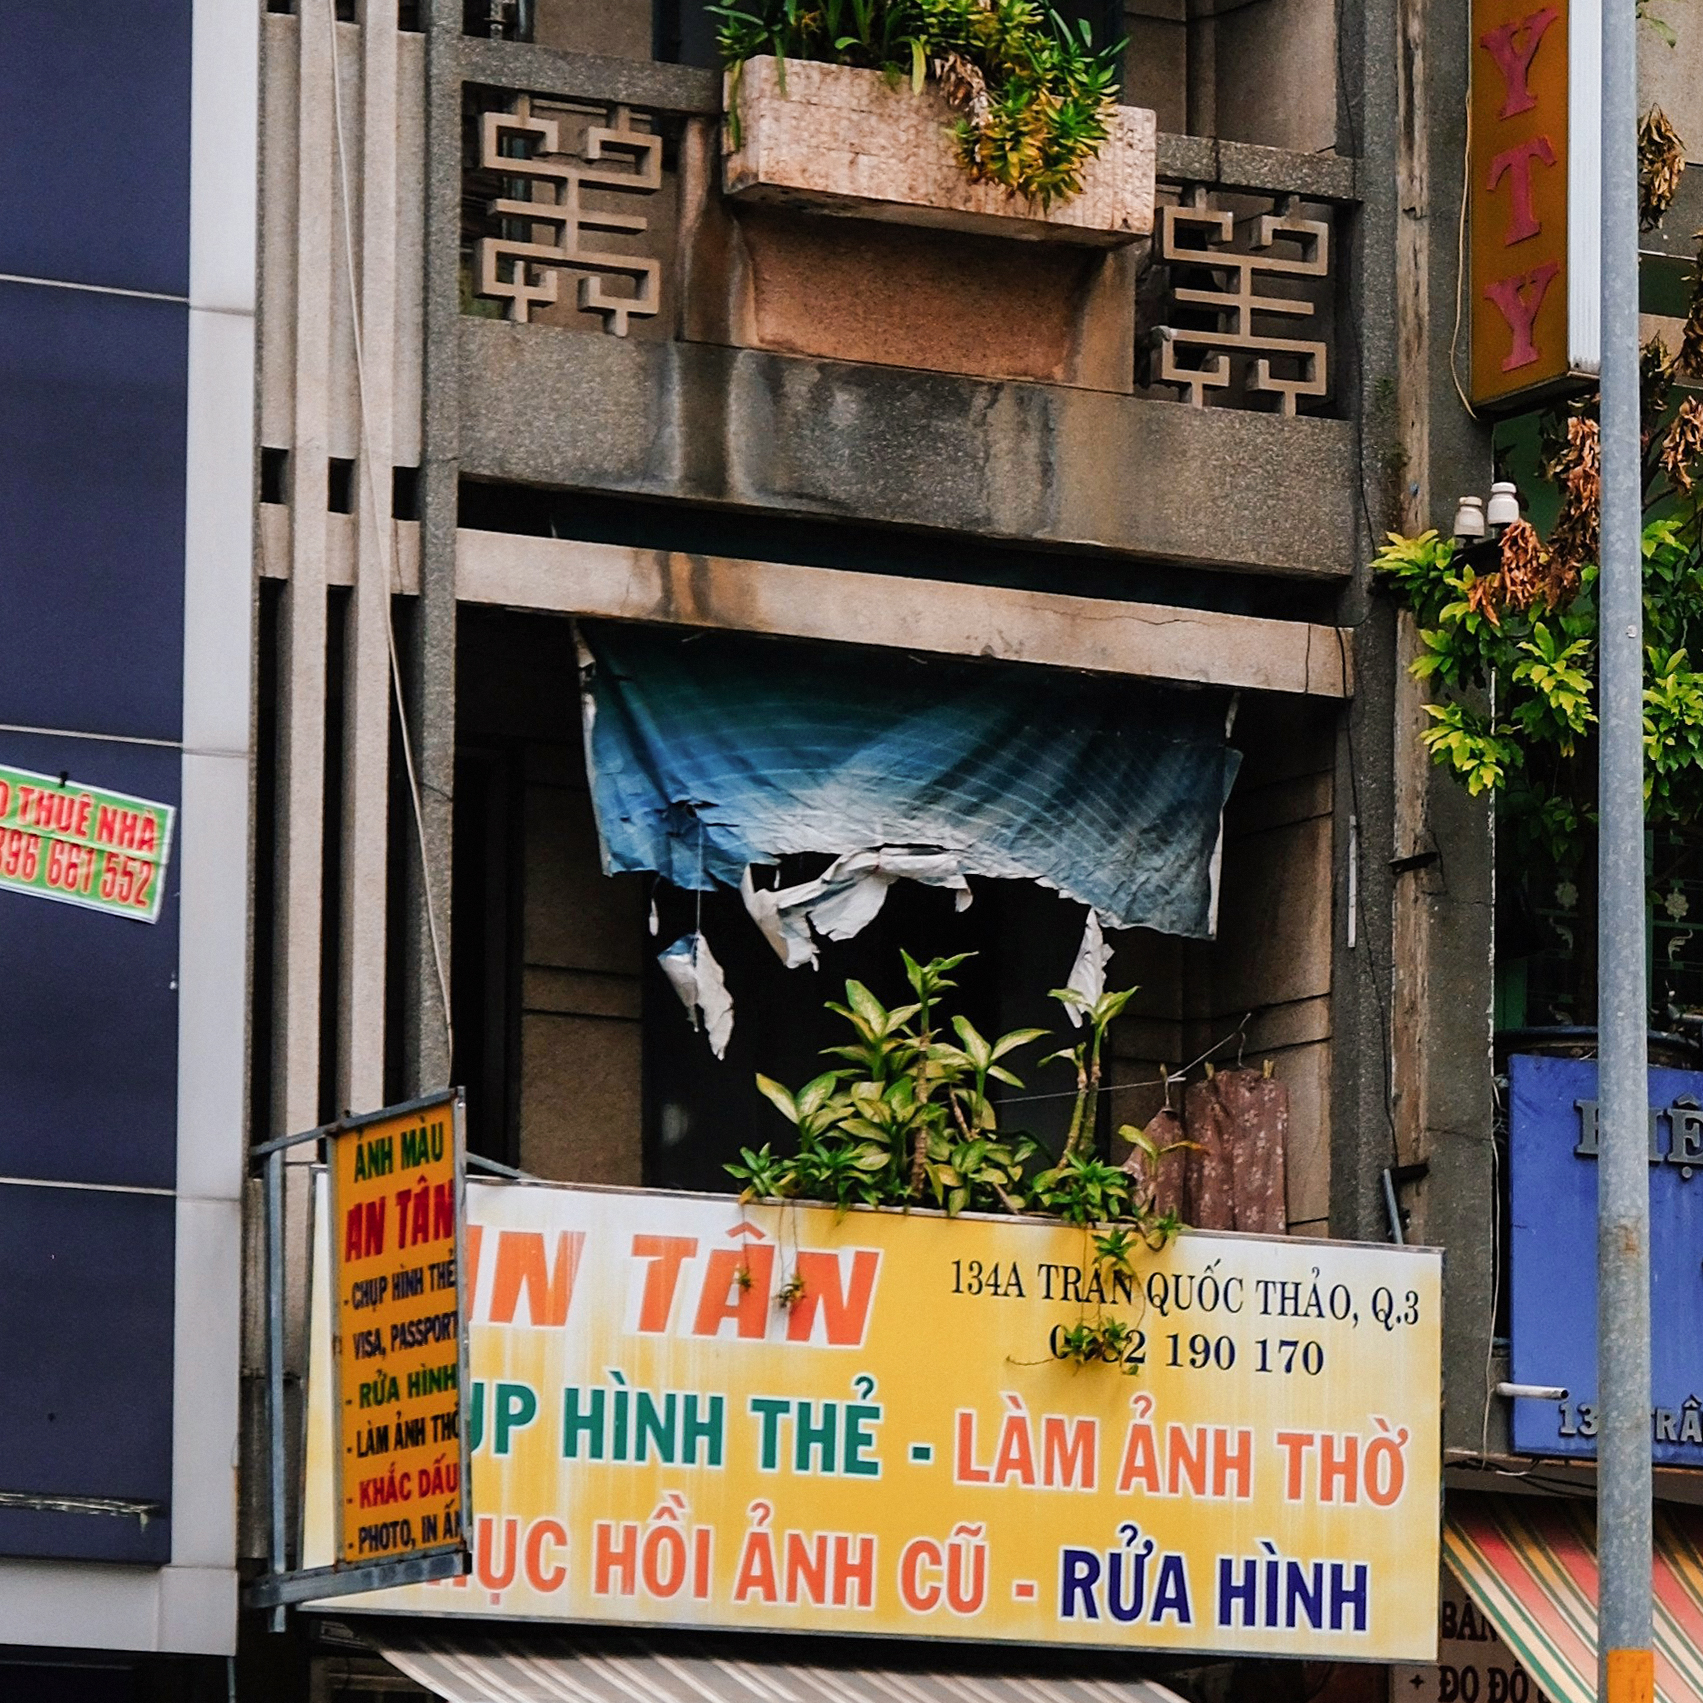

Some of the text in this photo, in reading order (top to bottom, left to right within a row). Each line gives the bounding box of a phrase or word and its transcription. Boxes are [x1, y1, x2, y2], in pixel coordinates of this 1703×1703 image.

[18, 786, 93, 838] THUÊ
[97, 807, 157, 853] NHÀ
[47, 839, 153, 908] 661 552
[354, 1114, 444, 1184] ẢNH MÀU
[345, 1174, 455, 1264] AN TÂN
[631, 1221, 882, 1347] TÂN
[951, 1259, 1026, 1298] 134A
[1147, 1258, 1245, 1317] QUỐC
[1256, 1266, 1360, 1328] THẢO,
[1371, 1285, 1421, 1332] Q.3
[391, 1310, 459, 1354] PASSPORT
[1049, 1323, 1325, 1377] 02 190 170
[356, 1410, 427, 1459] LÀM ẢNH
[563, 1370, 724, 1467] HÌNH
[749, 1374, 882, 1477] THẺ
[956, 1394, 1098, 1492] LÀM
[1118, 1393, 1253, 1499] ẢNH
[1276, 1417, 1409, 1507] THỜ
[358, 1453, 460, 1510] KHẮC DẤU
[421, 1513, 438, 1544] IN
[594, 1493, 710, 1600] HỒI
[734, 1502, 873, 1609] ẢNH
[901, 1523, 985, 1615] CŨ
[1059, 1523, 1192, 1625] RỬA
[1217, 1541, 1368, 1632] HÌNH
